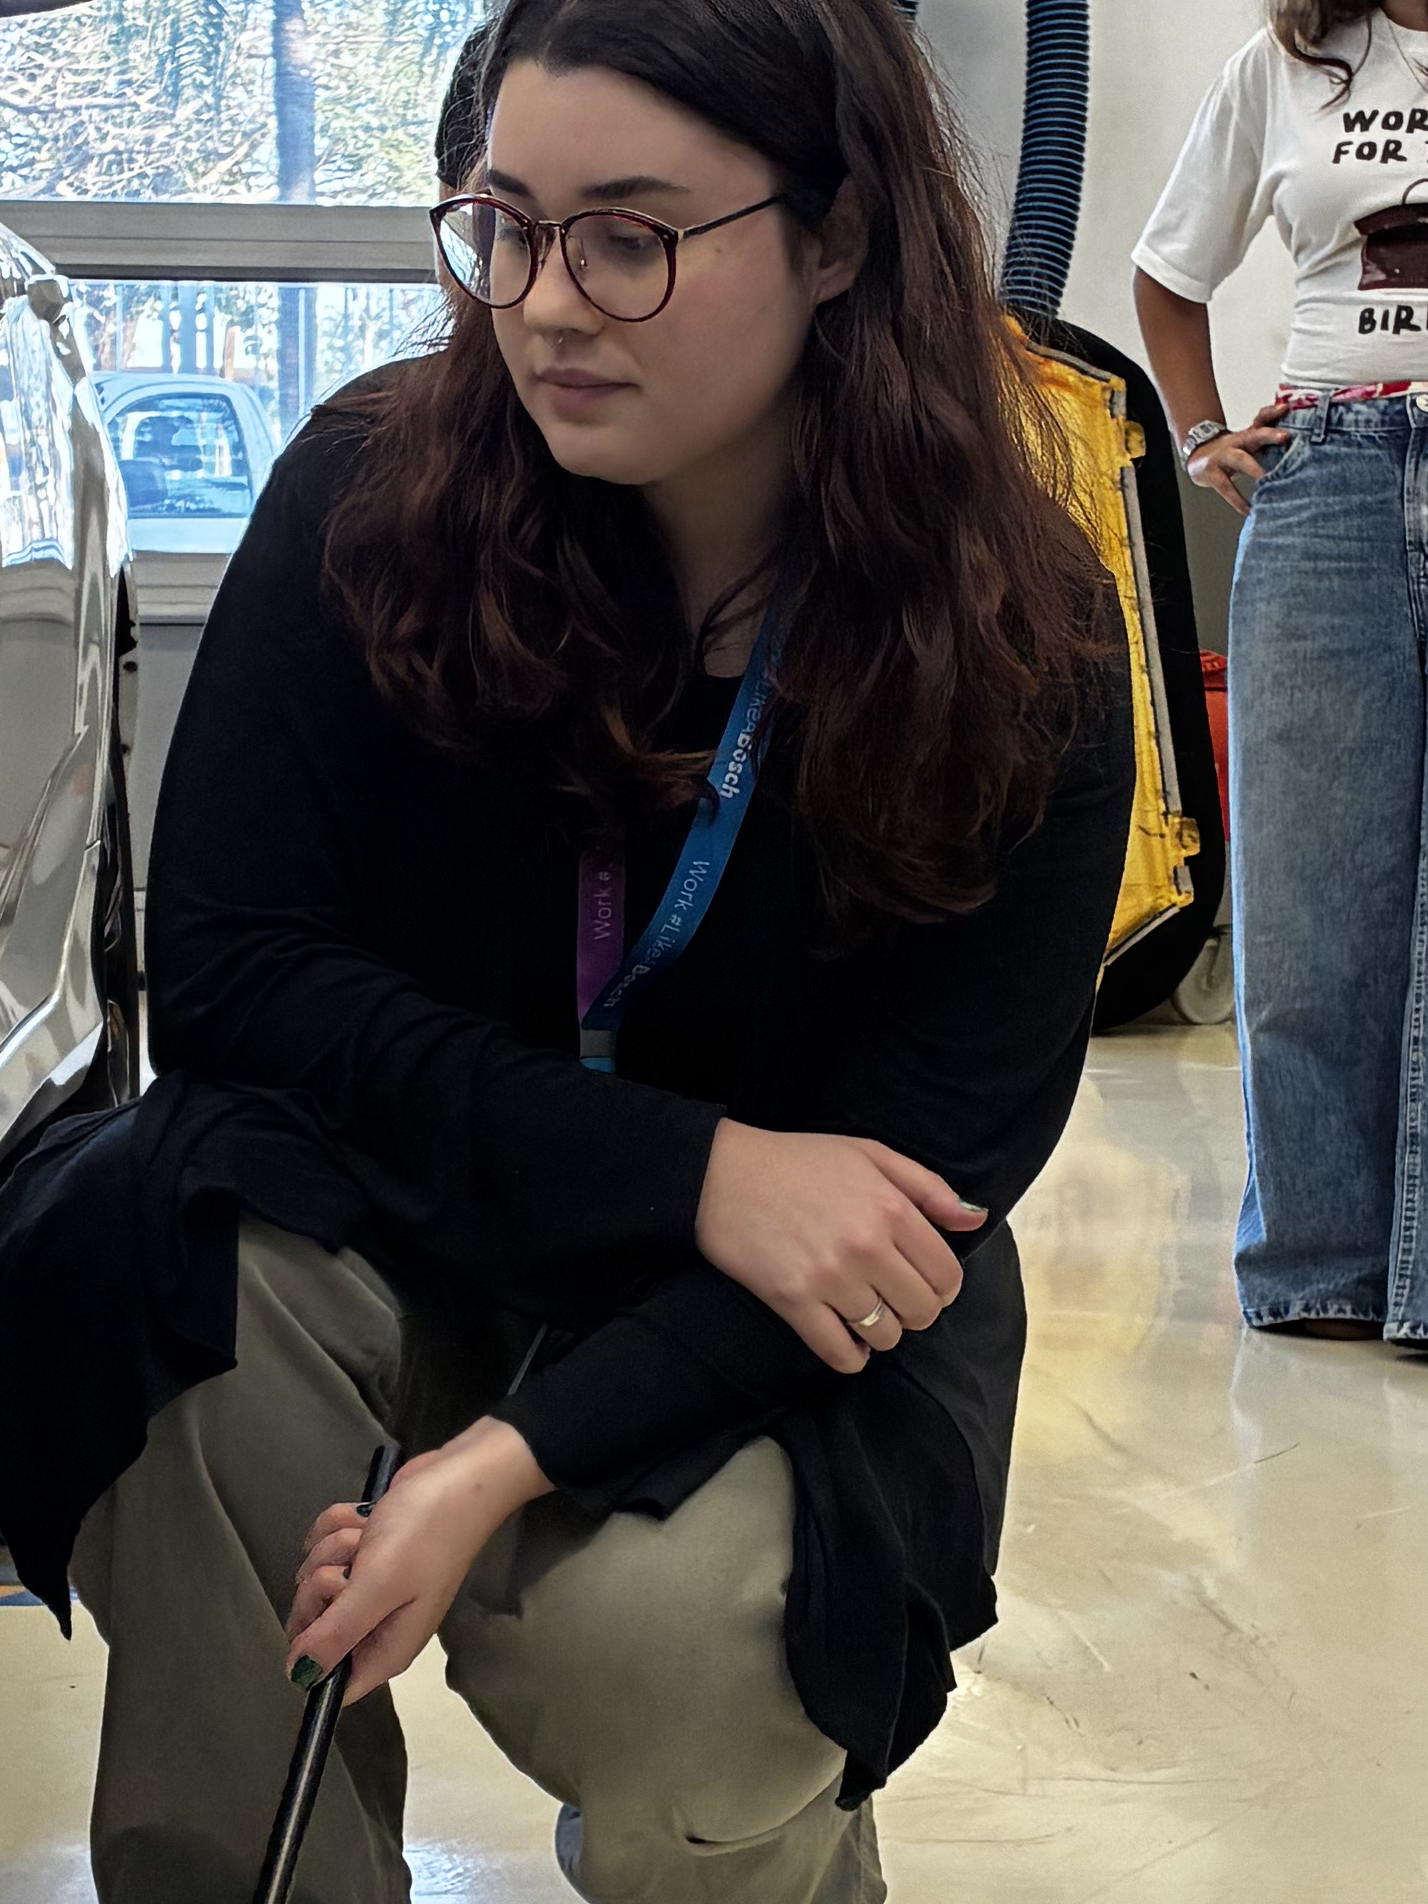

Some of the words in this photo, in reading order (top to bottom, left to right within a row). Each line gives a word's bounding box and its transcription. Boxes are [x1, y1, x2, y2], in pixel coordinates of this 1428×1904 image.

[1331, 138, 1408, 165] FOR
[674, 860, 710, 911] Work
[593, 887, 614, 941] Work
